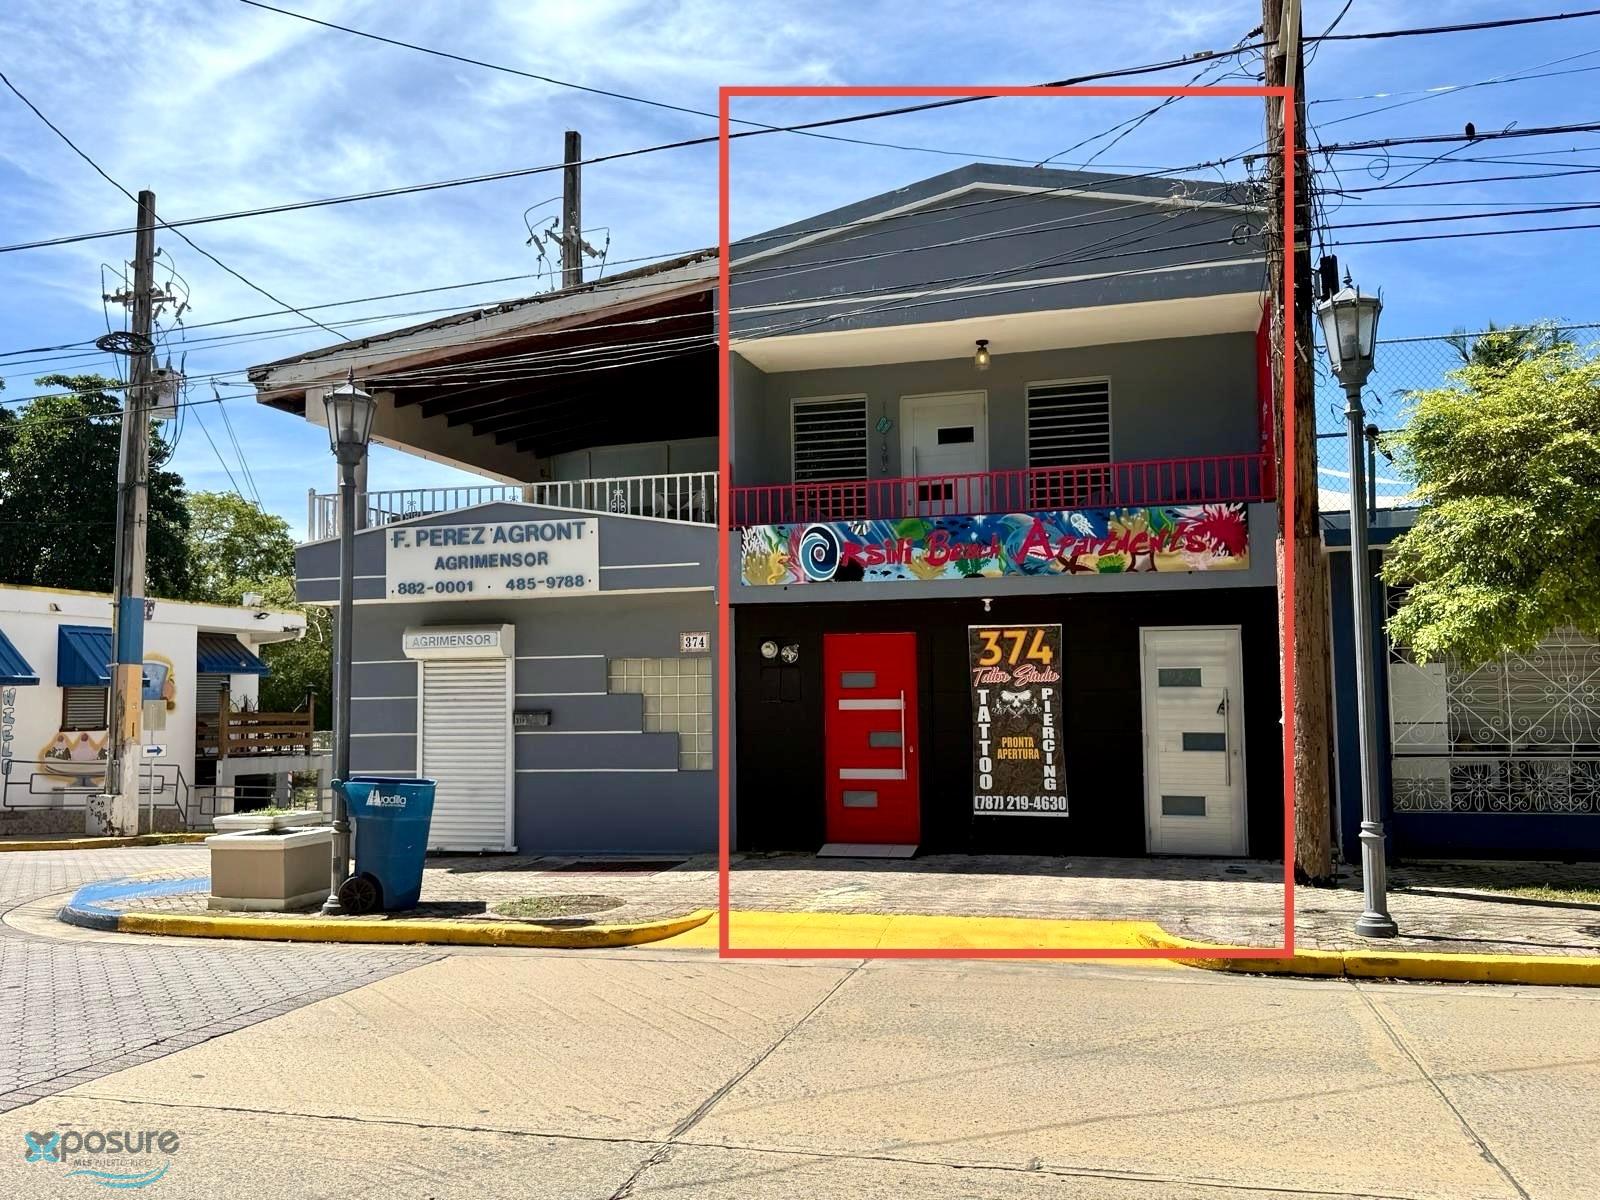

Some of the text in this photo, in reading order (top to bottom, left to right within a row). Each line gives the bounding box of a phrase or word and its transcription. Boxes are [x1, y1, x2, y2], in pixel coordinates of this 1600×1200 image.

[393, 521, 586, 548] F. PEREZ AGRONT
[434, 551, 549, 570] AGRIMENSOR
[397, 574, 585, 595] 882-0001 485-9788
[412, 634, 492, 647] AGRIMENSOR
[685, 636, 705, 647] 374
[979, 629, 1053, 666] 374
[973, 663, 1060, 687] Tattoo Studio
[977, 689, 993, 790] TATTOO
[1001, 736, 1035, 748] PRONTA
[1041, 687, 1057, 791] PIERCING
[997, 748, 1040, 760] APERTURA
[974, 795, 1067, 810] (787) 219-4630
